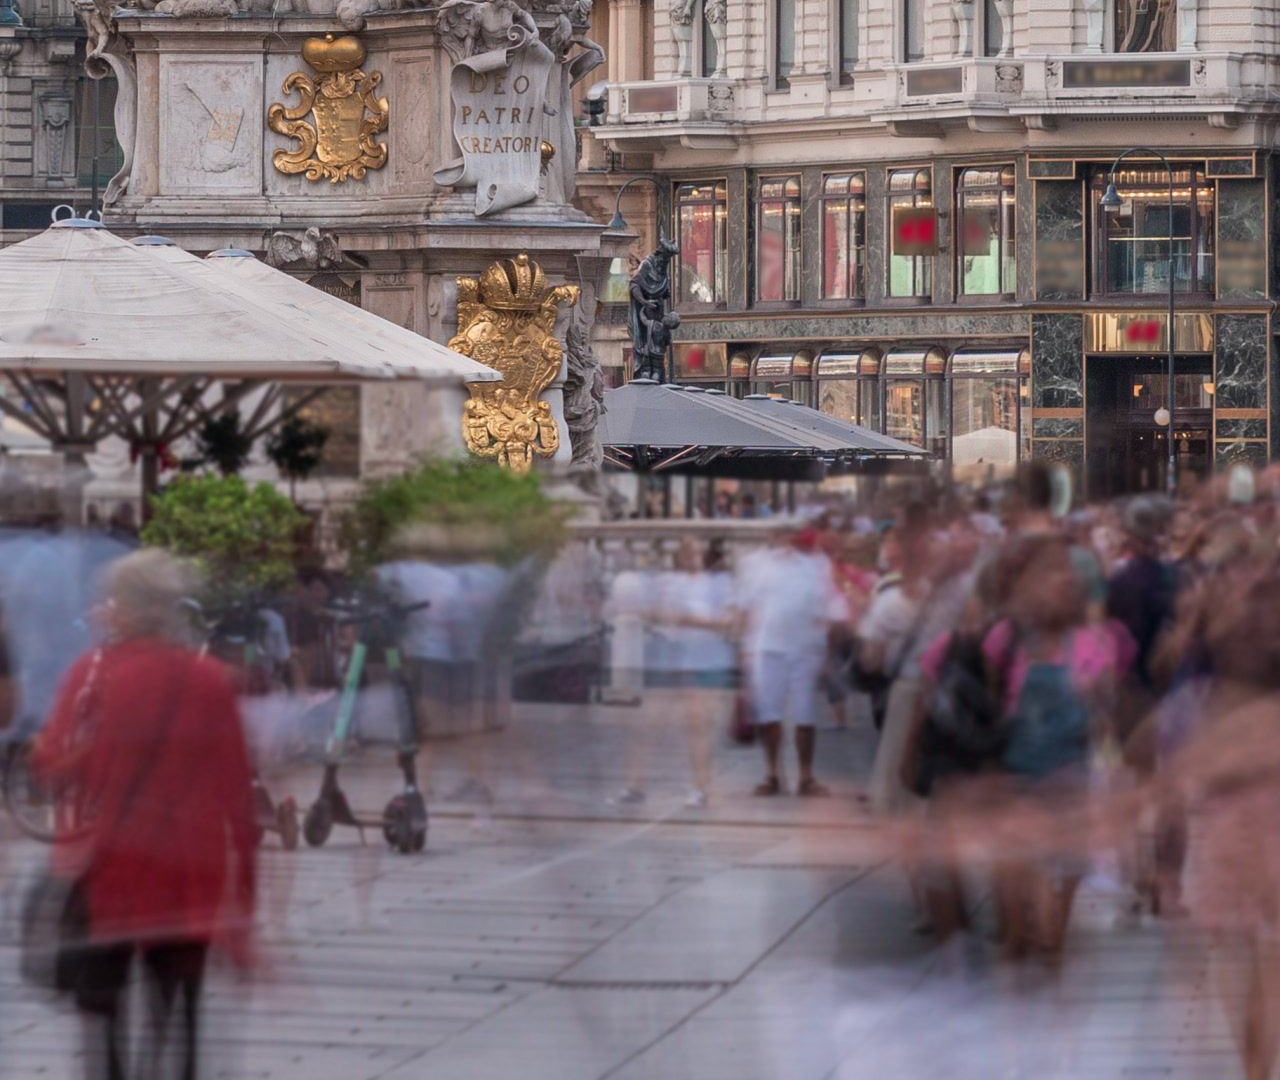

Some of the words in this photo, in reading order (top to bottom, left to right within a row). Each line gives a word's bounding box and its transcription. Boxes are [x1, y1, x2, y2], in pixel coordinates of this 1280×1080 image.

[468, 71, 530, 95] DEO
[461, 105, 535, 125] PATRI
[460, 135, 540, 154] CREATORI
